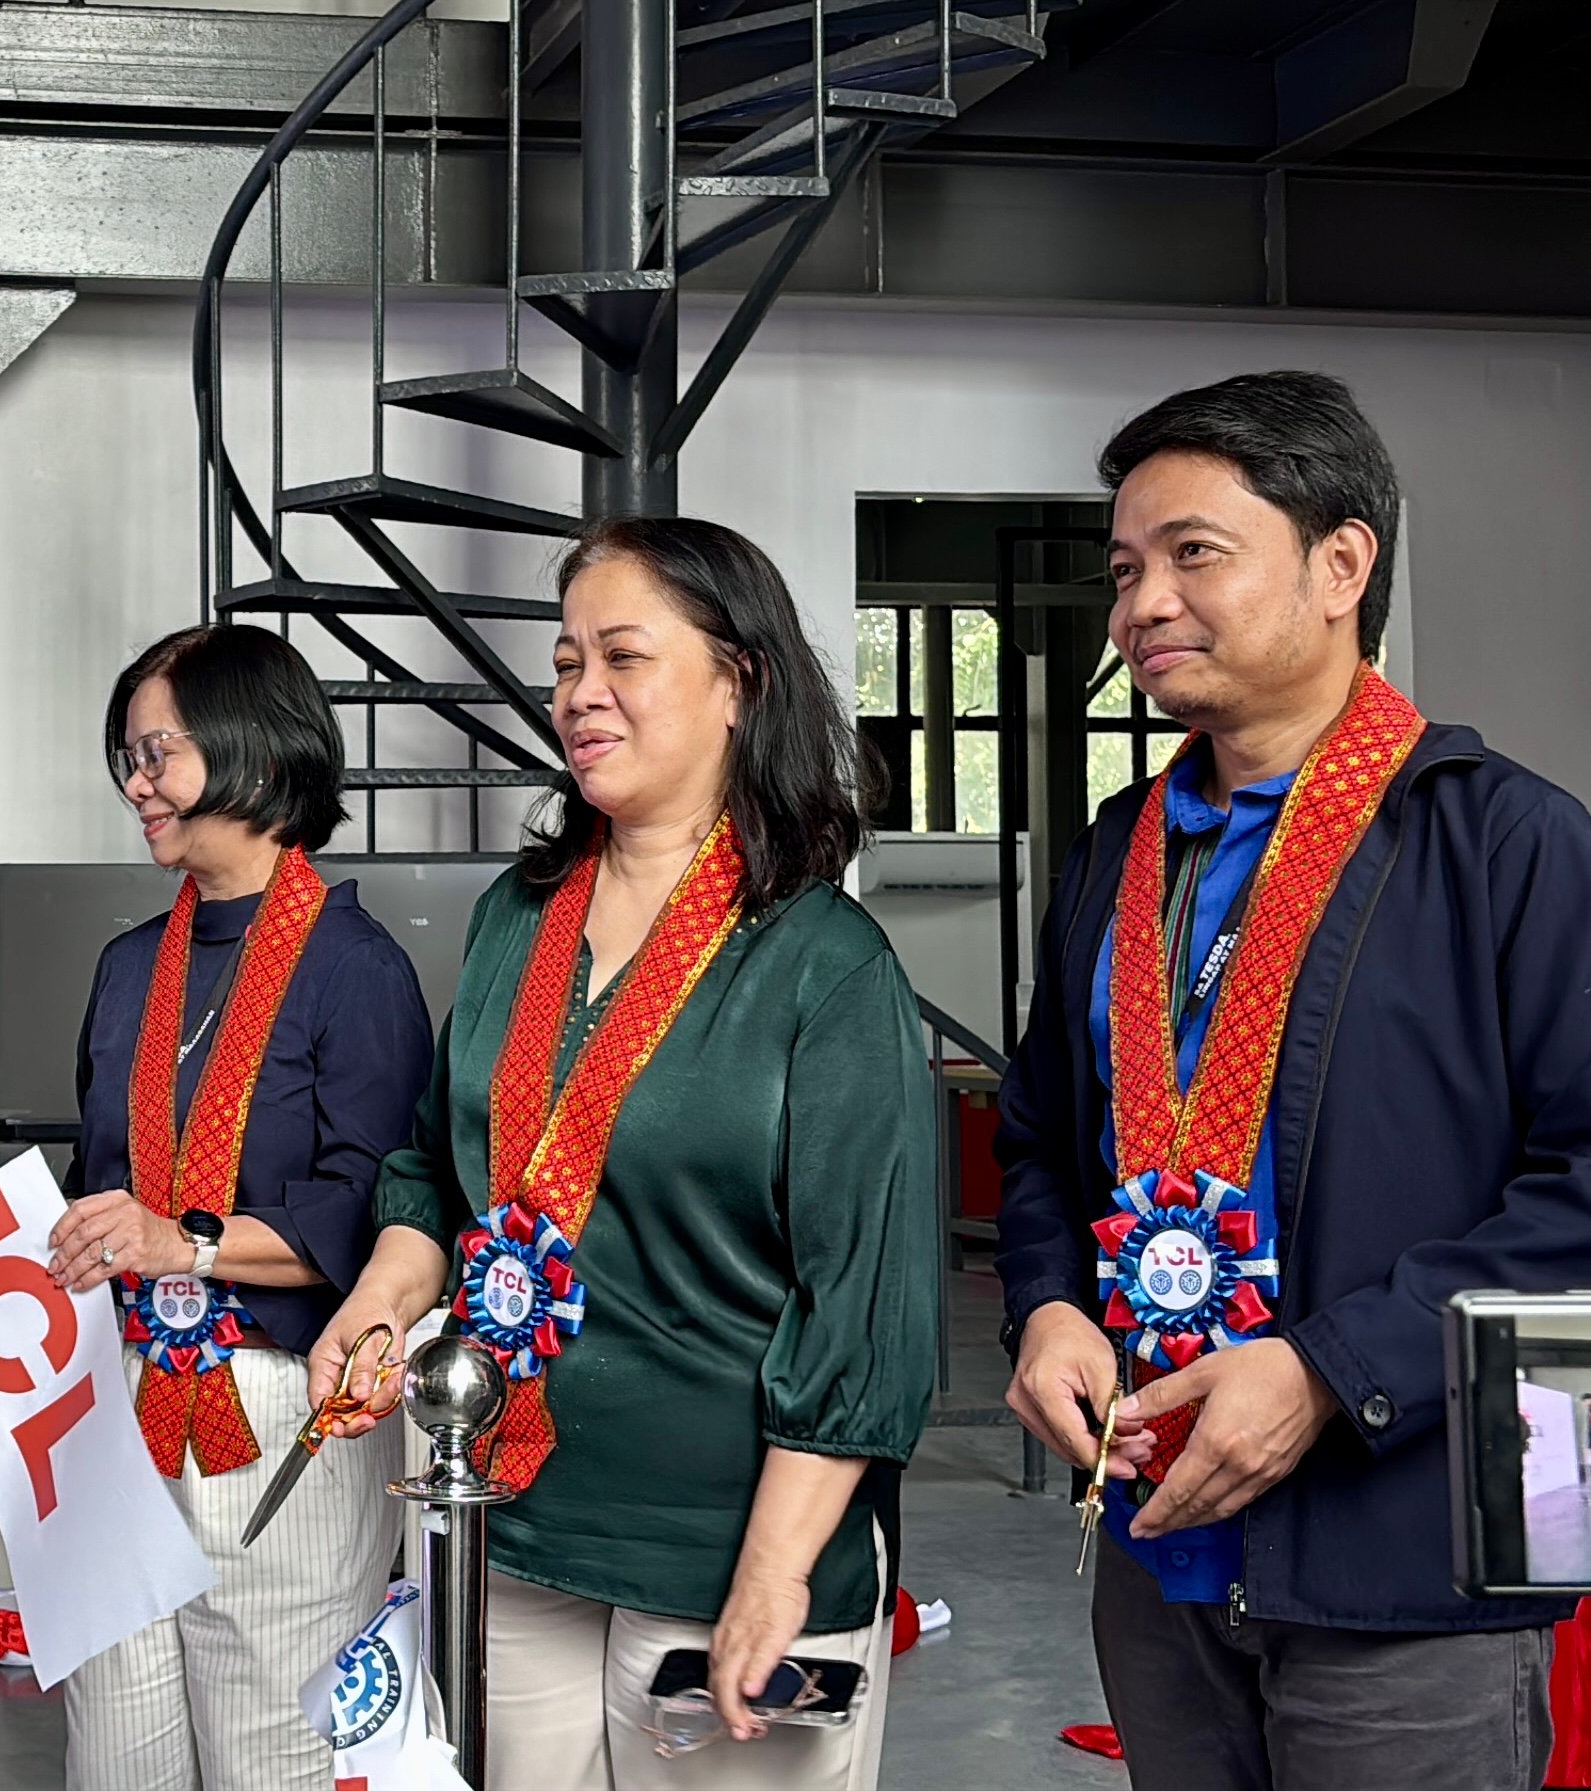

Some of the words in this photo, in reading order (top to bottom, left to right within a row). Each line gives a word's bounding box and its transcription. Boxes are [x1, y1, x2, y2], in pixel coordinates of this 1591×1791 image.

[158, 1281, 201, 1297] TCL
[492, 1266, 527, 1295] TCL
[355, 1669, 400, 1741] TRAINING
